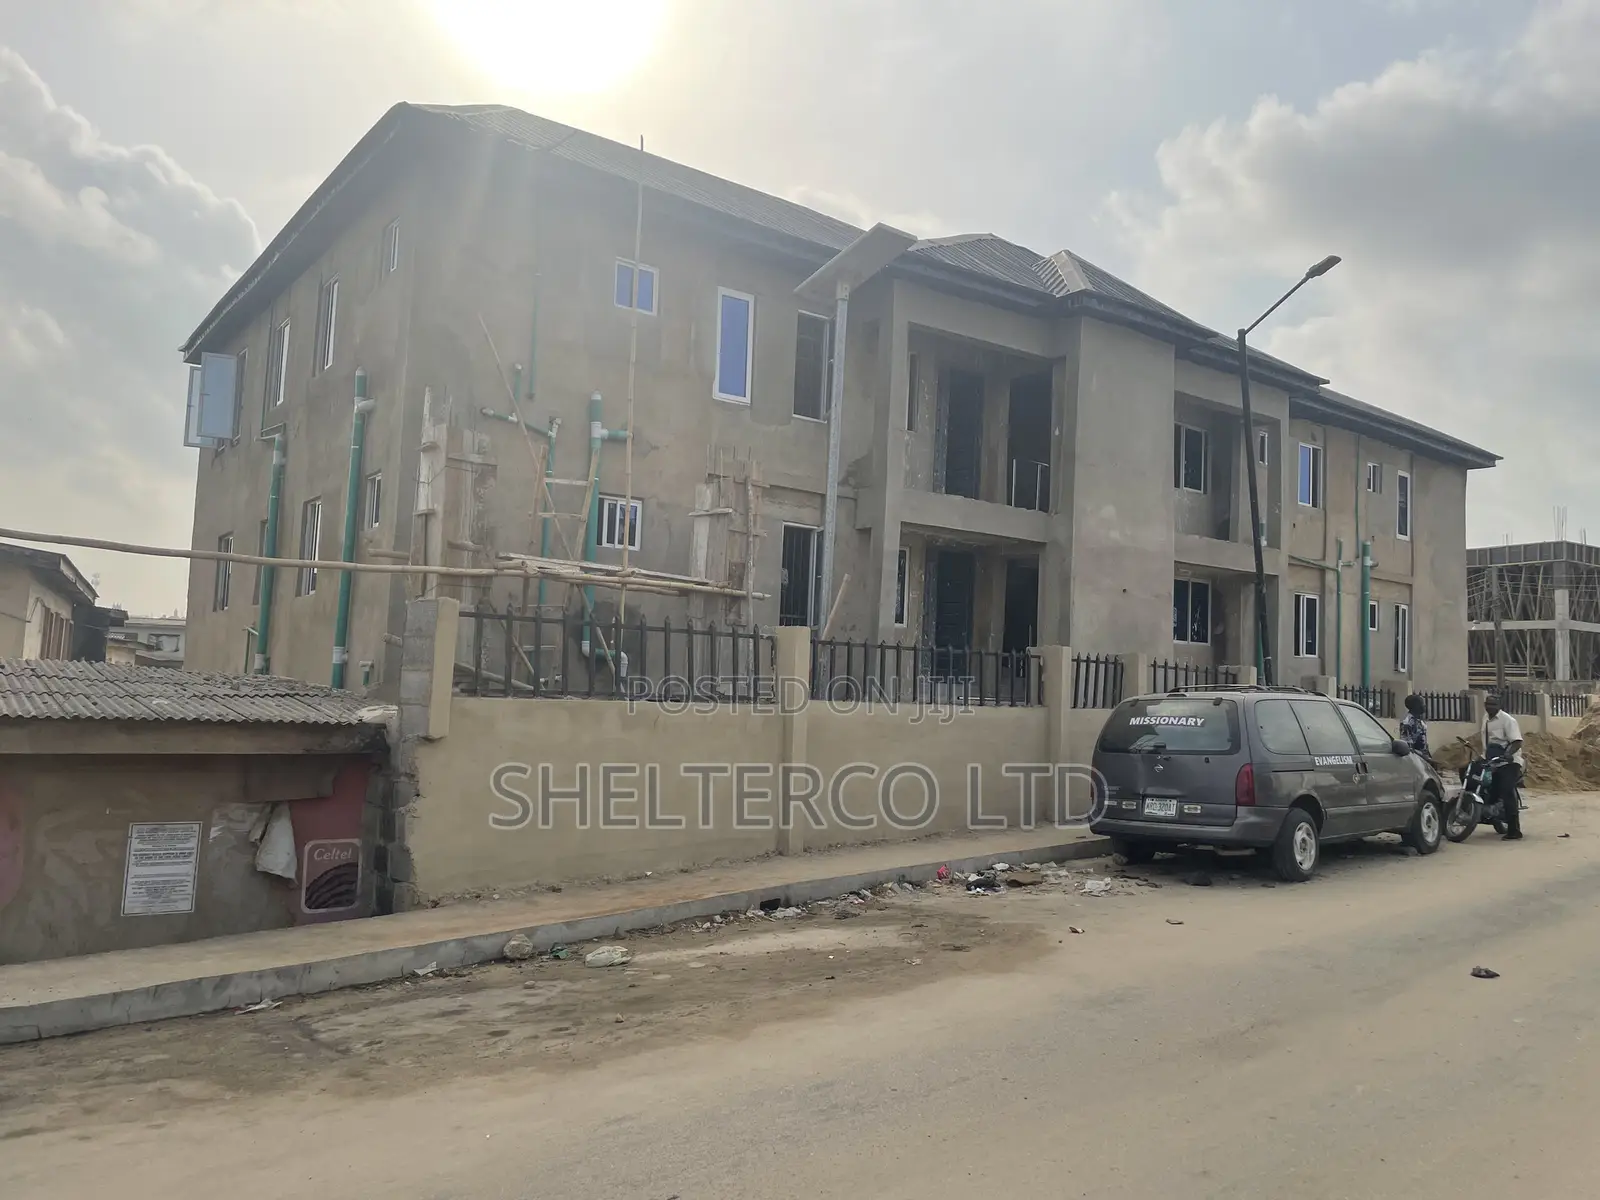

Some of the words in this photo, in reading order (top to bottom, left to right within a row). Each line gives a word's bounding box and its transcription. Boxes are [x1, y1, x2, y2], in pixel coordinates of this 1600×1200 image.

[1129, 716, 1205, 726] MISSIONARY
[1314, 755, 1354, 766] EVANGELISM
[313, 847, 352, 861] Celtel
